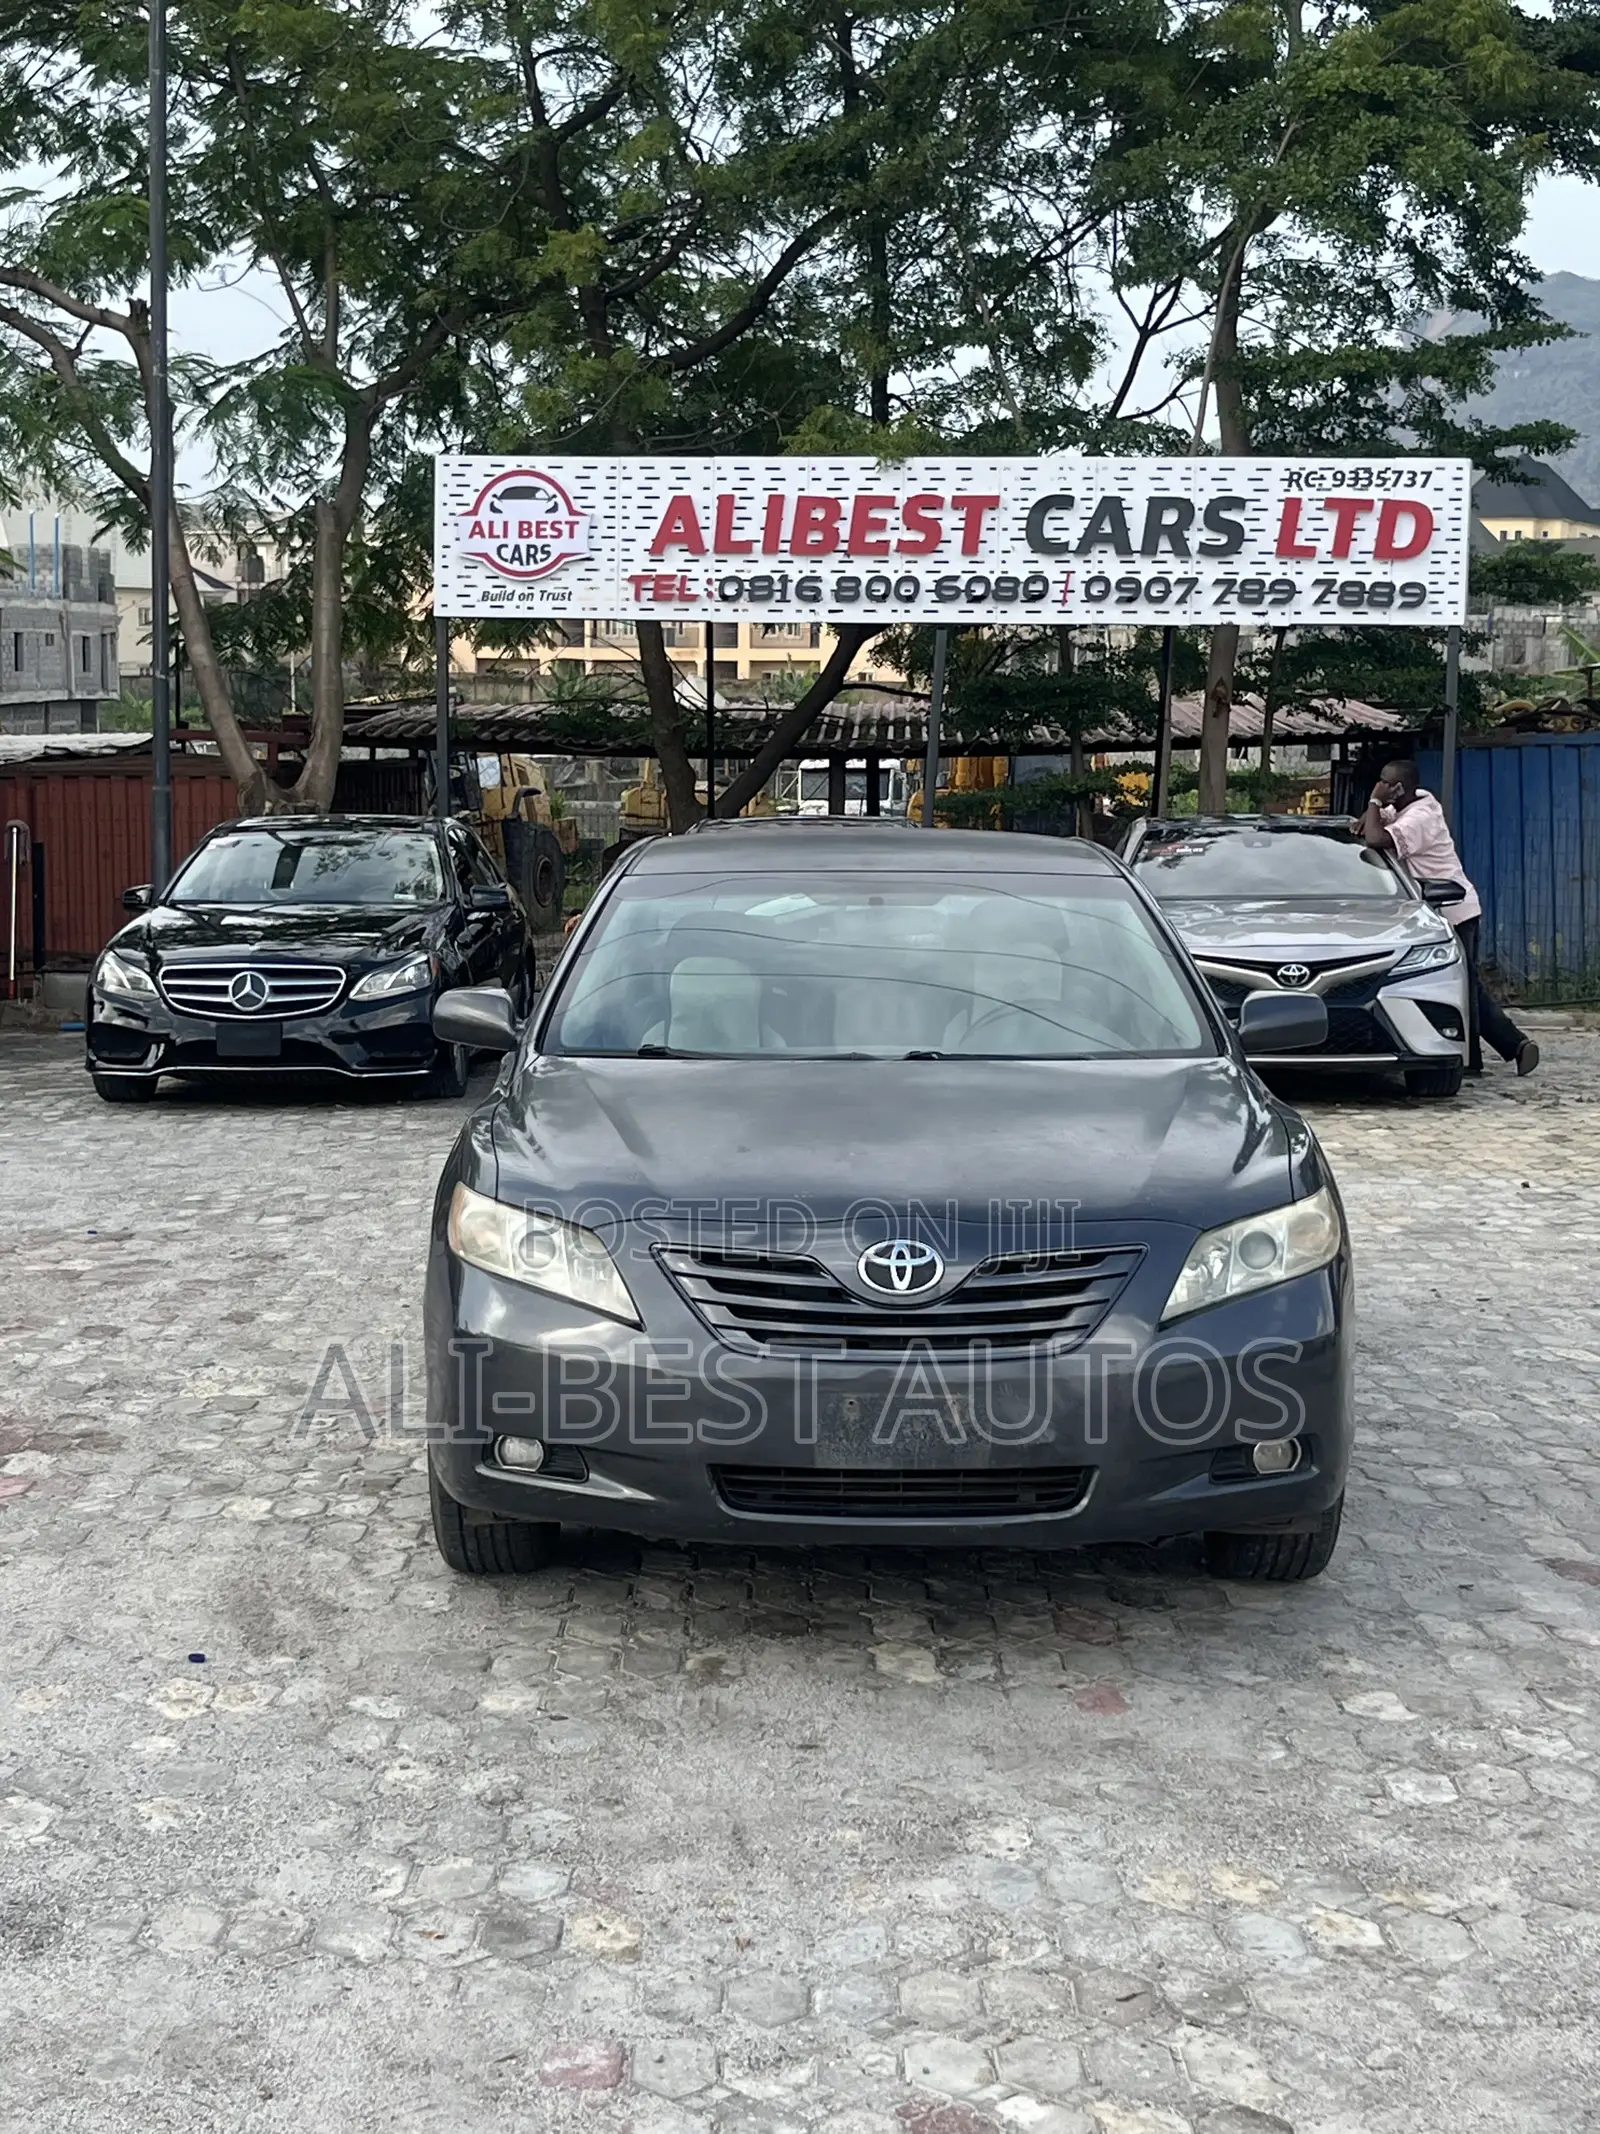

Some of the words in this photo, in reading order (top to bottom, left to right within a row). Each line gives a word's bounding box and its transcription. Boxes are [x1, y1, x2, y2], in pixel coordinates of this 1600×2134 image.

[468, 520, 509, 539] ALI
[518, 520, 580, 539] BEST
[648, 494, 1000, 557] ALIBEST
[1025, 494, 1247, 559] CARS
[1275, 496, 1435, 561] LTD
[496, 543, 551, 567] CARS
[481, 589, 516, 602] Build
[518, 594, 534, 602] on
[539, 589, 573, 602] Trust
[834, 575, 920, 603] 800
[934, 575, 1050, 603] 6080
[1084, 575, 1199, 606] 0907
[1211, 578, 1297, 607] 789
[1311, 578, 1427, 608] 7889
